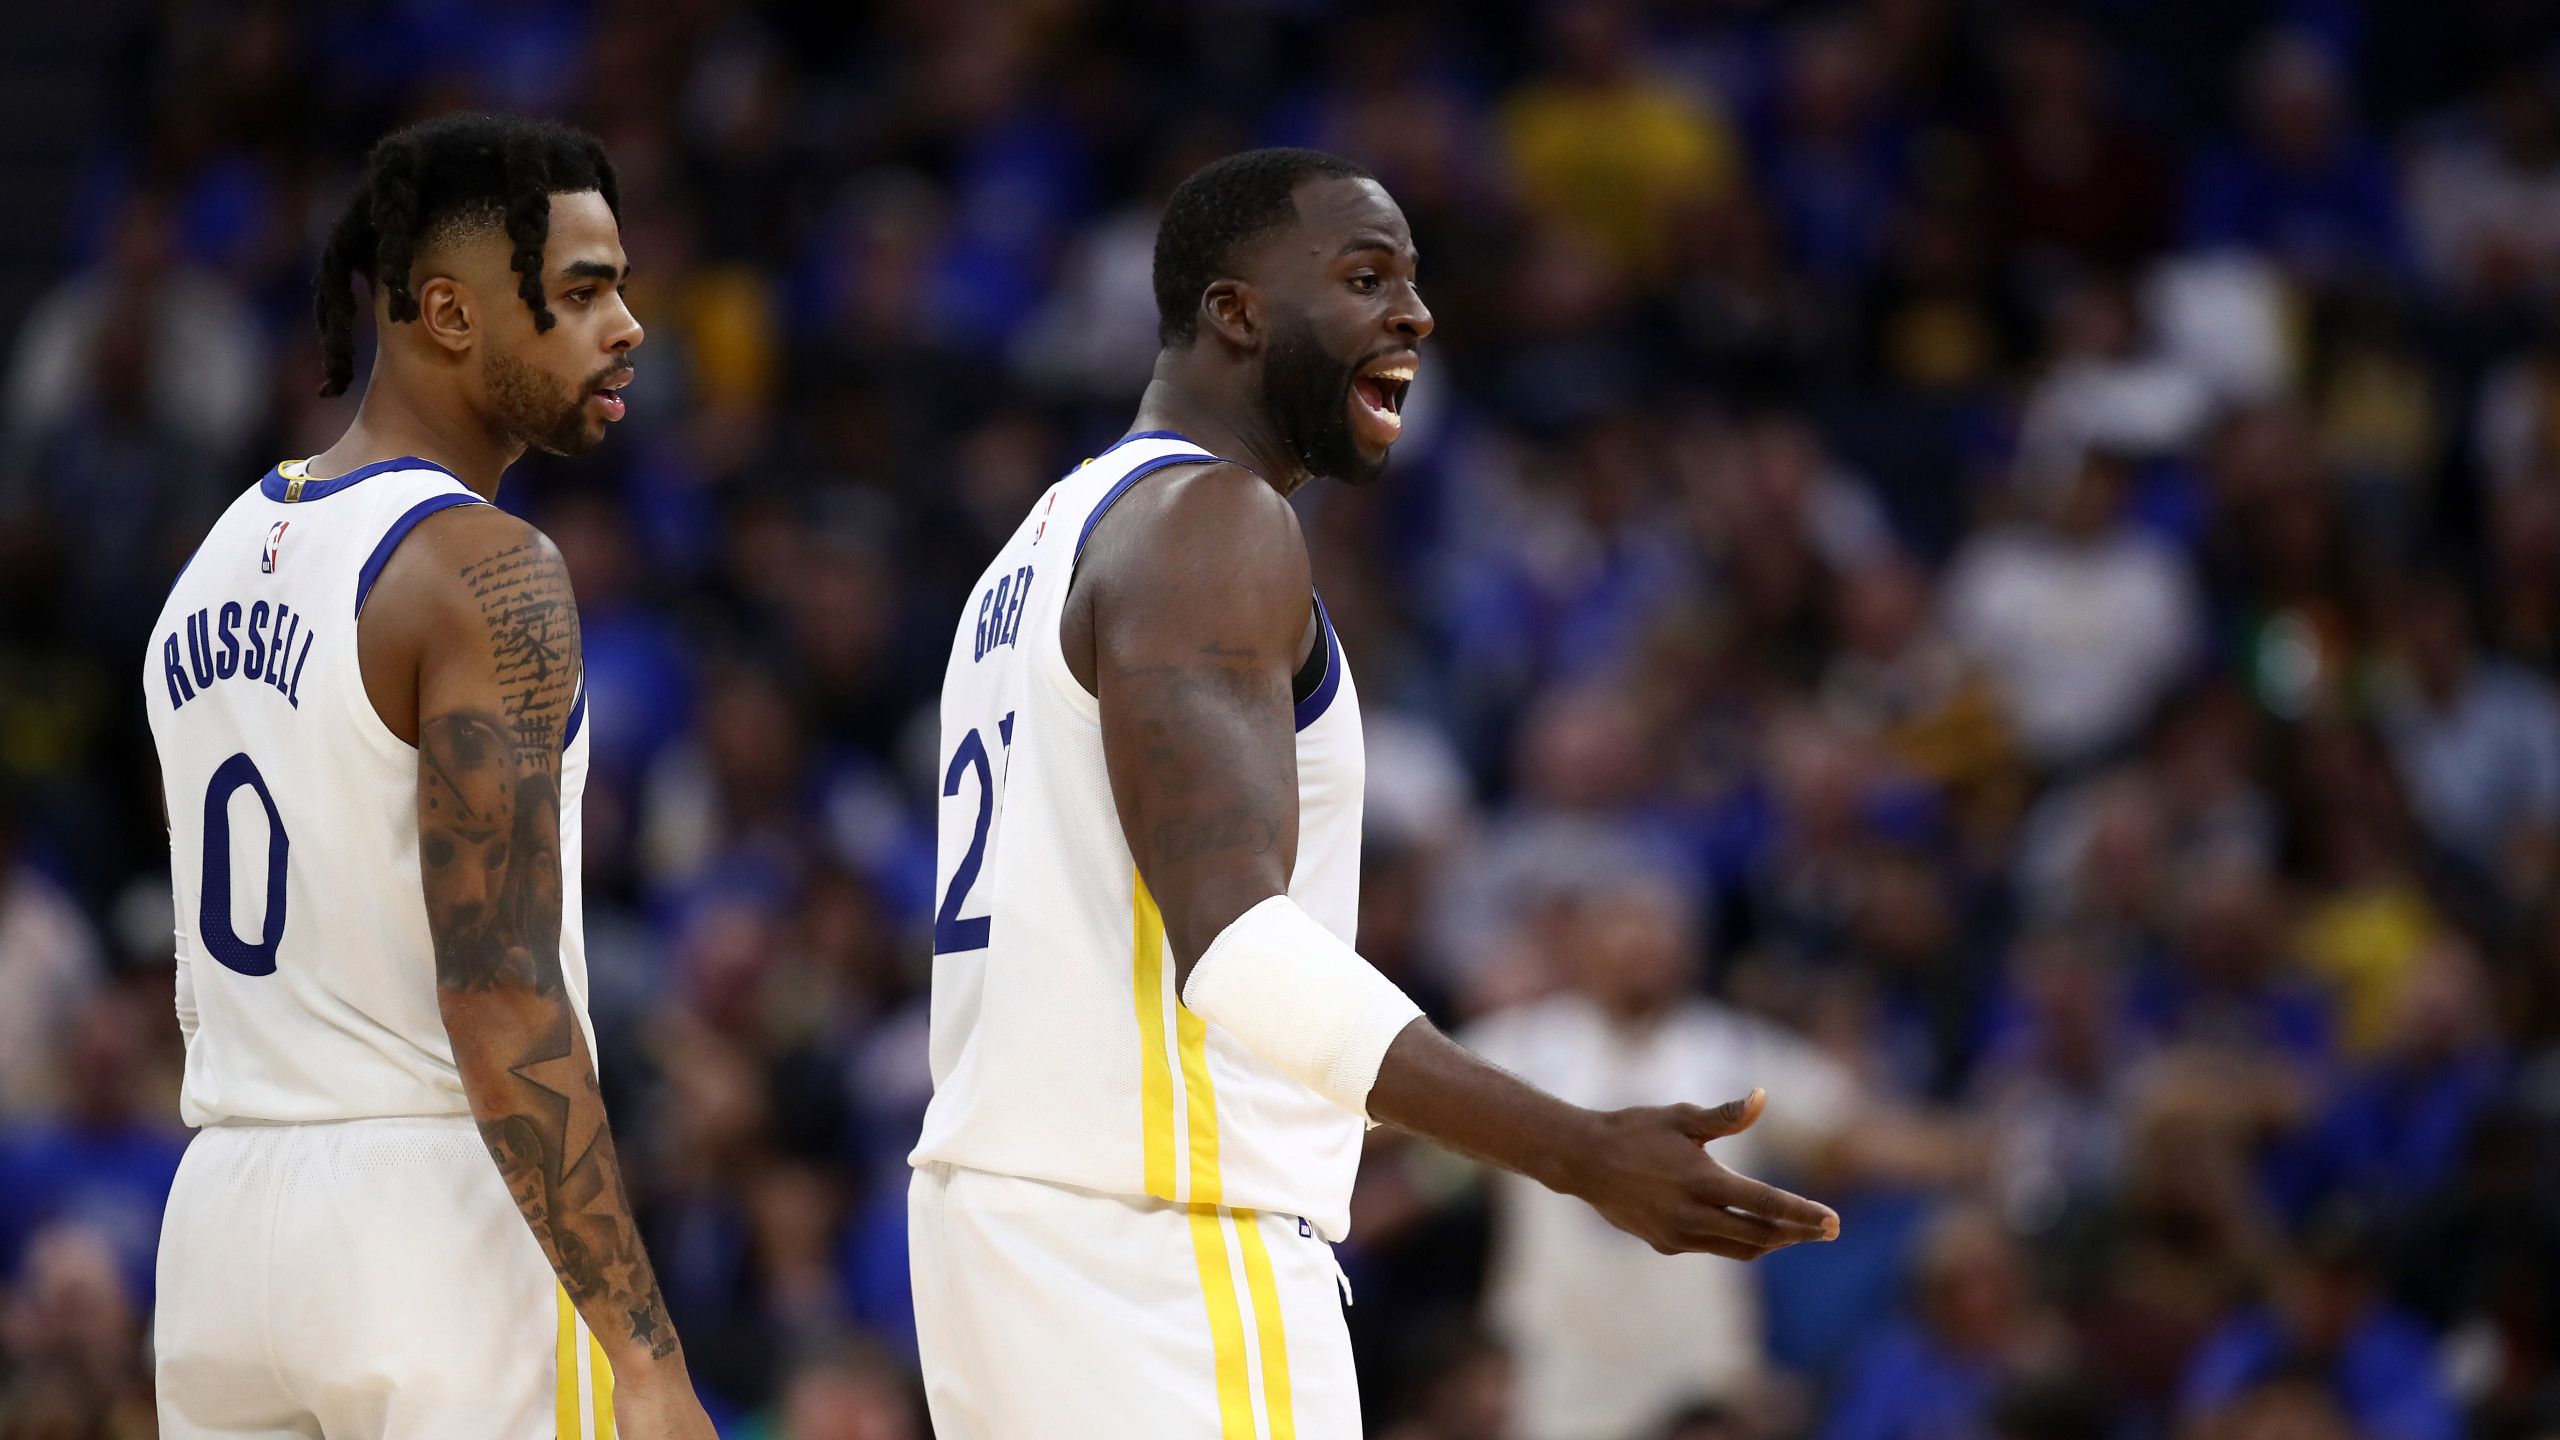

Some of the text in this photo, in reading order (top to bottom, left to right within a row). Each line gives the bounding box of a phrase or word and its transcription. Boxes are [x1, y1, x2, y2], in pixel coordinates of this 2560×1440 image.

[164, 600, 314, 711] RUSSELL
[199, 752, 290, 977] 0
[934, 711, 1016, 956] 2
